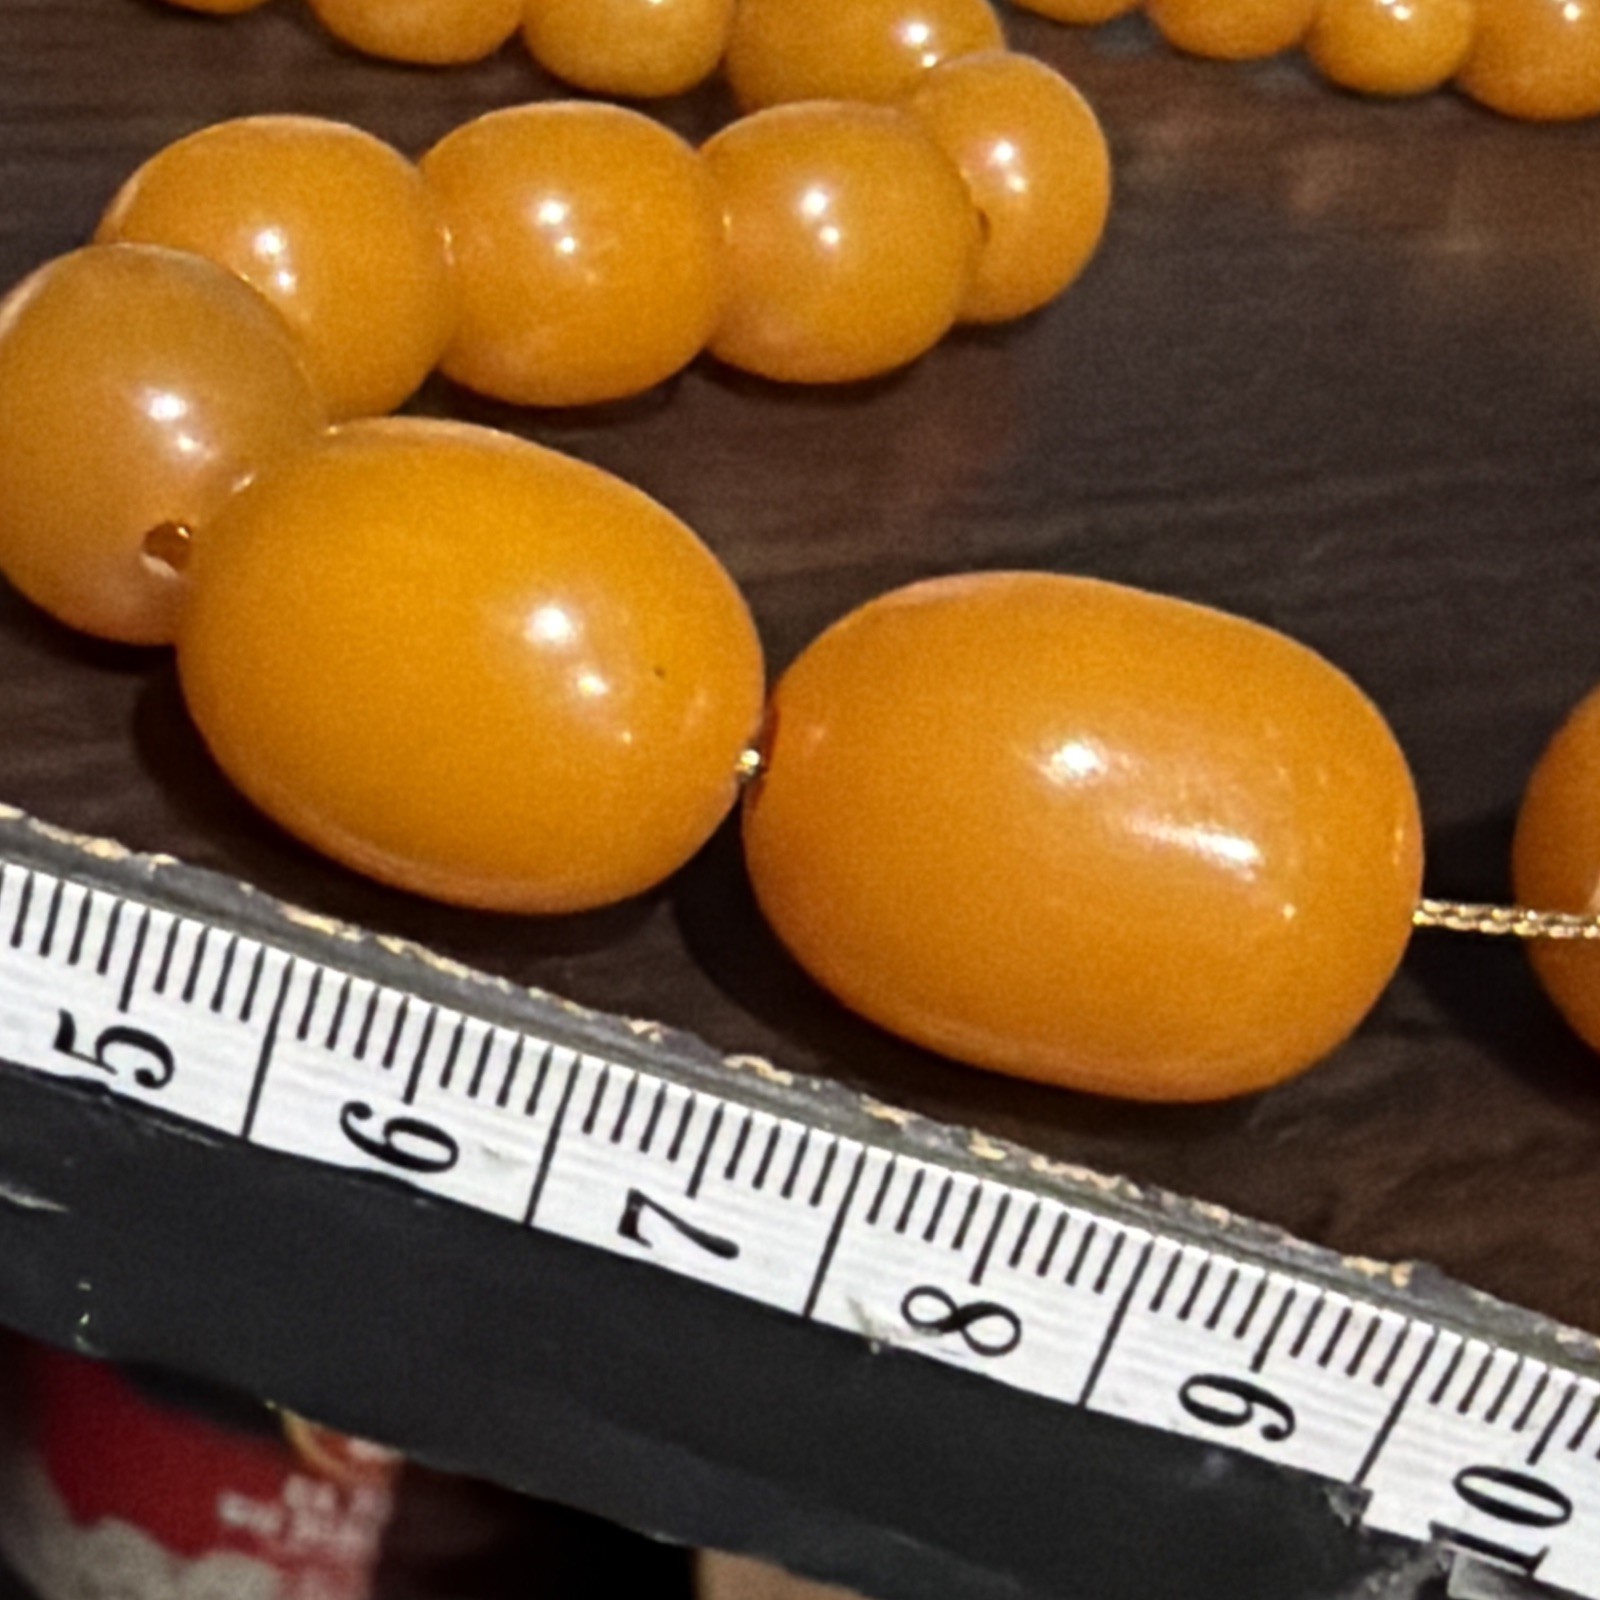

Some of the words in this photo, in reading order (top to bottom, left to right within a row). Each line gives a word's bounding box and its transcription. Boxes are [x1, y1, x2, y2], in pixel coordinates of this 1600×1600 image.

[52, 1009, 175, 1090] 5
[340, 1101, 460, 1174] 6
[617, 1188, 740, 1260] 7
[900, 1285, 1022, 1357] 8
[1178, 1373, 1296, 1442] 9
[1428, 1465, 1574, 1578] 10
